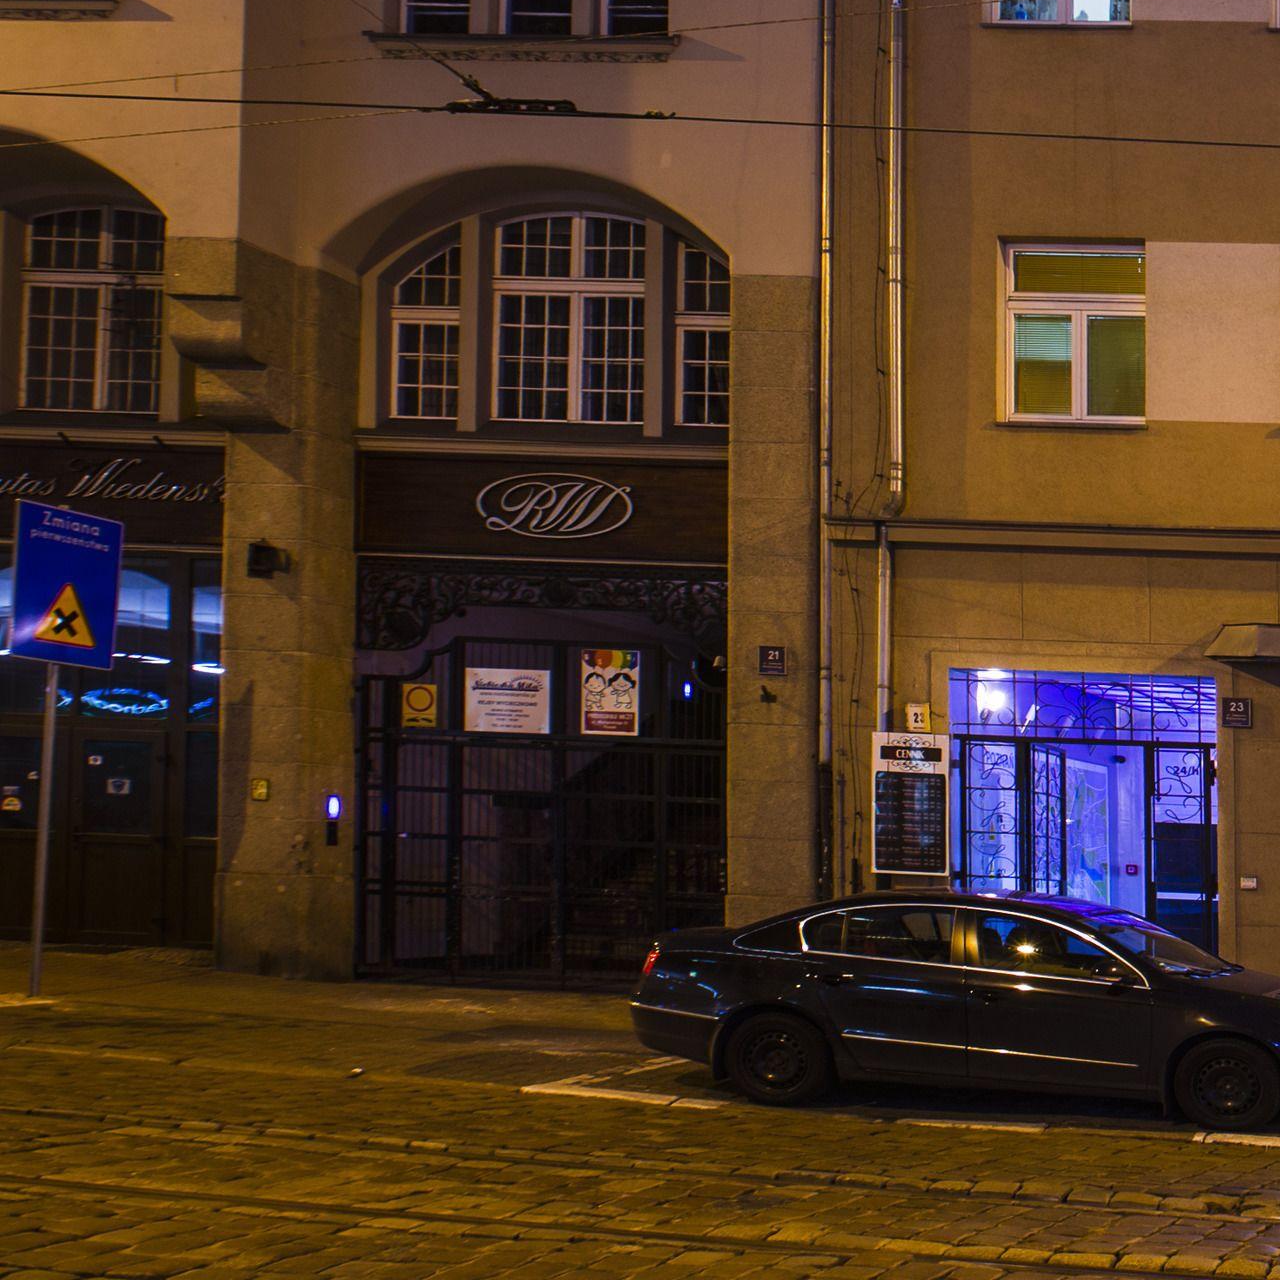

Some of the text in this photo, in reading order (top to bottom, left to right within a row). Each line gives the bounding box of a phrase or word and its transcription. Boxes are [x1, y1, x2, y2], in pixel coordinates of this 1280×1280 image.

[42, 511, 100, 536] Zmiana
[767, 650, 780, 660] 21
[1229, 702, 1245, 712] 23
[913, 712, 926, 724] 23
